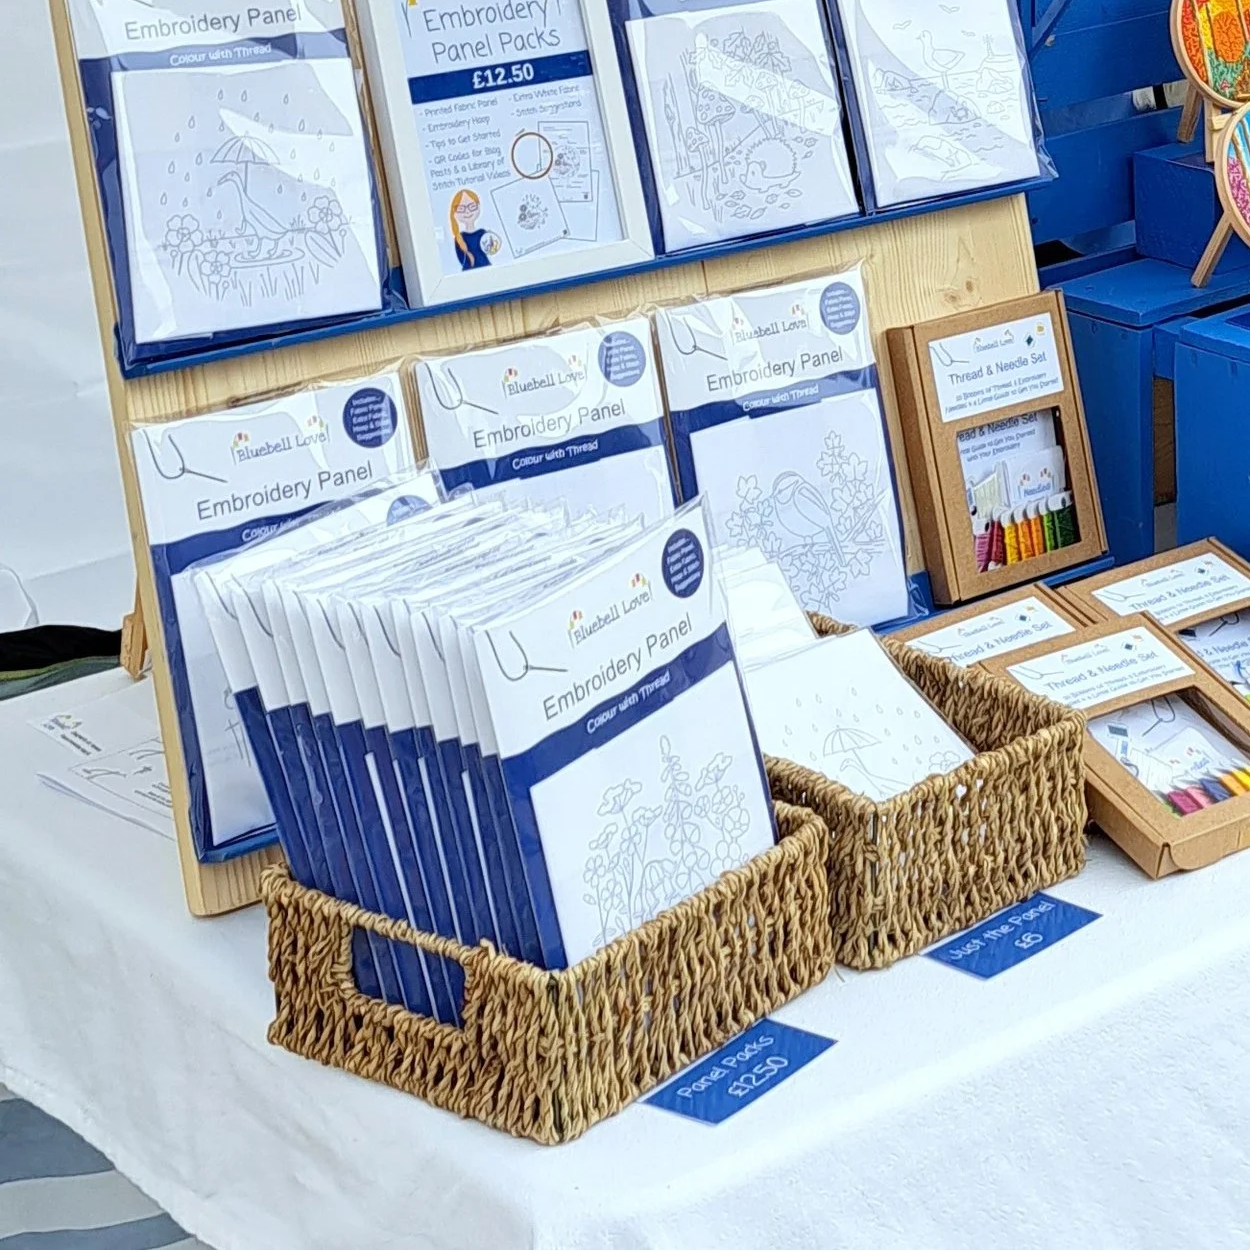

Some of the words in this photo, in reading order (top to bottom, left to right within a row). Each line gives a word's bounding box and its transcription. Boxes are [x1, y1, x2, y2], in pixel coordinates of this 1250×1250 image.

[125, 15, 240, 40] Embroidery
[248, 4, 301, 26] Panel
[170, 52, 206, 66] Colour
[209, 49, 232, 61] with
[234, 43, 271, 58] Thread
[432, 34, 493, 64] Panel
[499, 27, 561, 53] Packs
[472, 63, 534, 89] £12.50
[425, 106, 452, 117] Printed
[454, 103, 476, 111] Fabric
[478, 99, 498, 108] Panel
[513, 93, 533, 102] Extra
[535, 89, 558, 98] White
[559, 85, 579, 94] Fabric
[428, 117, 470, 132] Embroidery
[472, 116, 490, 125] Hoop
[430, 140, 445, 150] Tips
[458, 135, 471, 143] Get
[474, 130, 500, 141] Started
[448, 152, 470, 161] Codes
[485, 146, 501, 158] Blog
[431, 168, 452, 179] Posts
[468, 158, 496, 172] Library
[497, 157, 505, 165] of
[433, 180, 455, 190] Stitch
[457, 173, 485, 186] Tutorial
[487, 170, 511, 180] Videos
[507, 374, 556, 395] Bluebell
[558, 370, 584, 386] Love
[707, 359, 796, 392] Embroidery
[801, 346, 843, 370] Panel
[948, 368, 983, 385] Thread
[986, 366, 994, 375] &
[996, 357, 1028, 373] Needle
[1031, 352, 1047, 365] Set
[473, 414, 572, 449] Embroidery
[579, 398, 626, 424] Panel
[237, 438, 292, 462] Bluebell
[295, 432, 328, 447] Love
[512, 454, 543, 470] Colour
[546, 450, 565, 463] with
[566, 440, 599, 457] Thread
[197, 481, 312, 521] Embroidery
[318, 460, 373, 489] Panel
[1130, 596, 1165, 610] Thread
[1178, 583, 1210, 596] Needle
[1212, 574, 1230, 583] Set
[574, 606, 620, 645] Bluebell
[622, 591, 650, 614] Love
[543, 648, 642, 721] Embroidery
[646, 612, 693, 658] Panel
[1043, 674, 1086, 692] Thread
[1100, 659, 1137, 674] Needle
[1139, 651, 1158, 662] Set
[586, 706, 618, 734] Colour
[619, 693, 639, 712] with
[639, 670, 671, 698] Thread
[949, 938, 986, 960] Just
[983, 924, 1015, 941] the
[1008, 901, 1056, 926] Panel
[1014, 932, 1043, 949] £6
[677, 1067, 729, 1098] Panel
[722, 1035, 774, 1068] Packs
